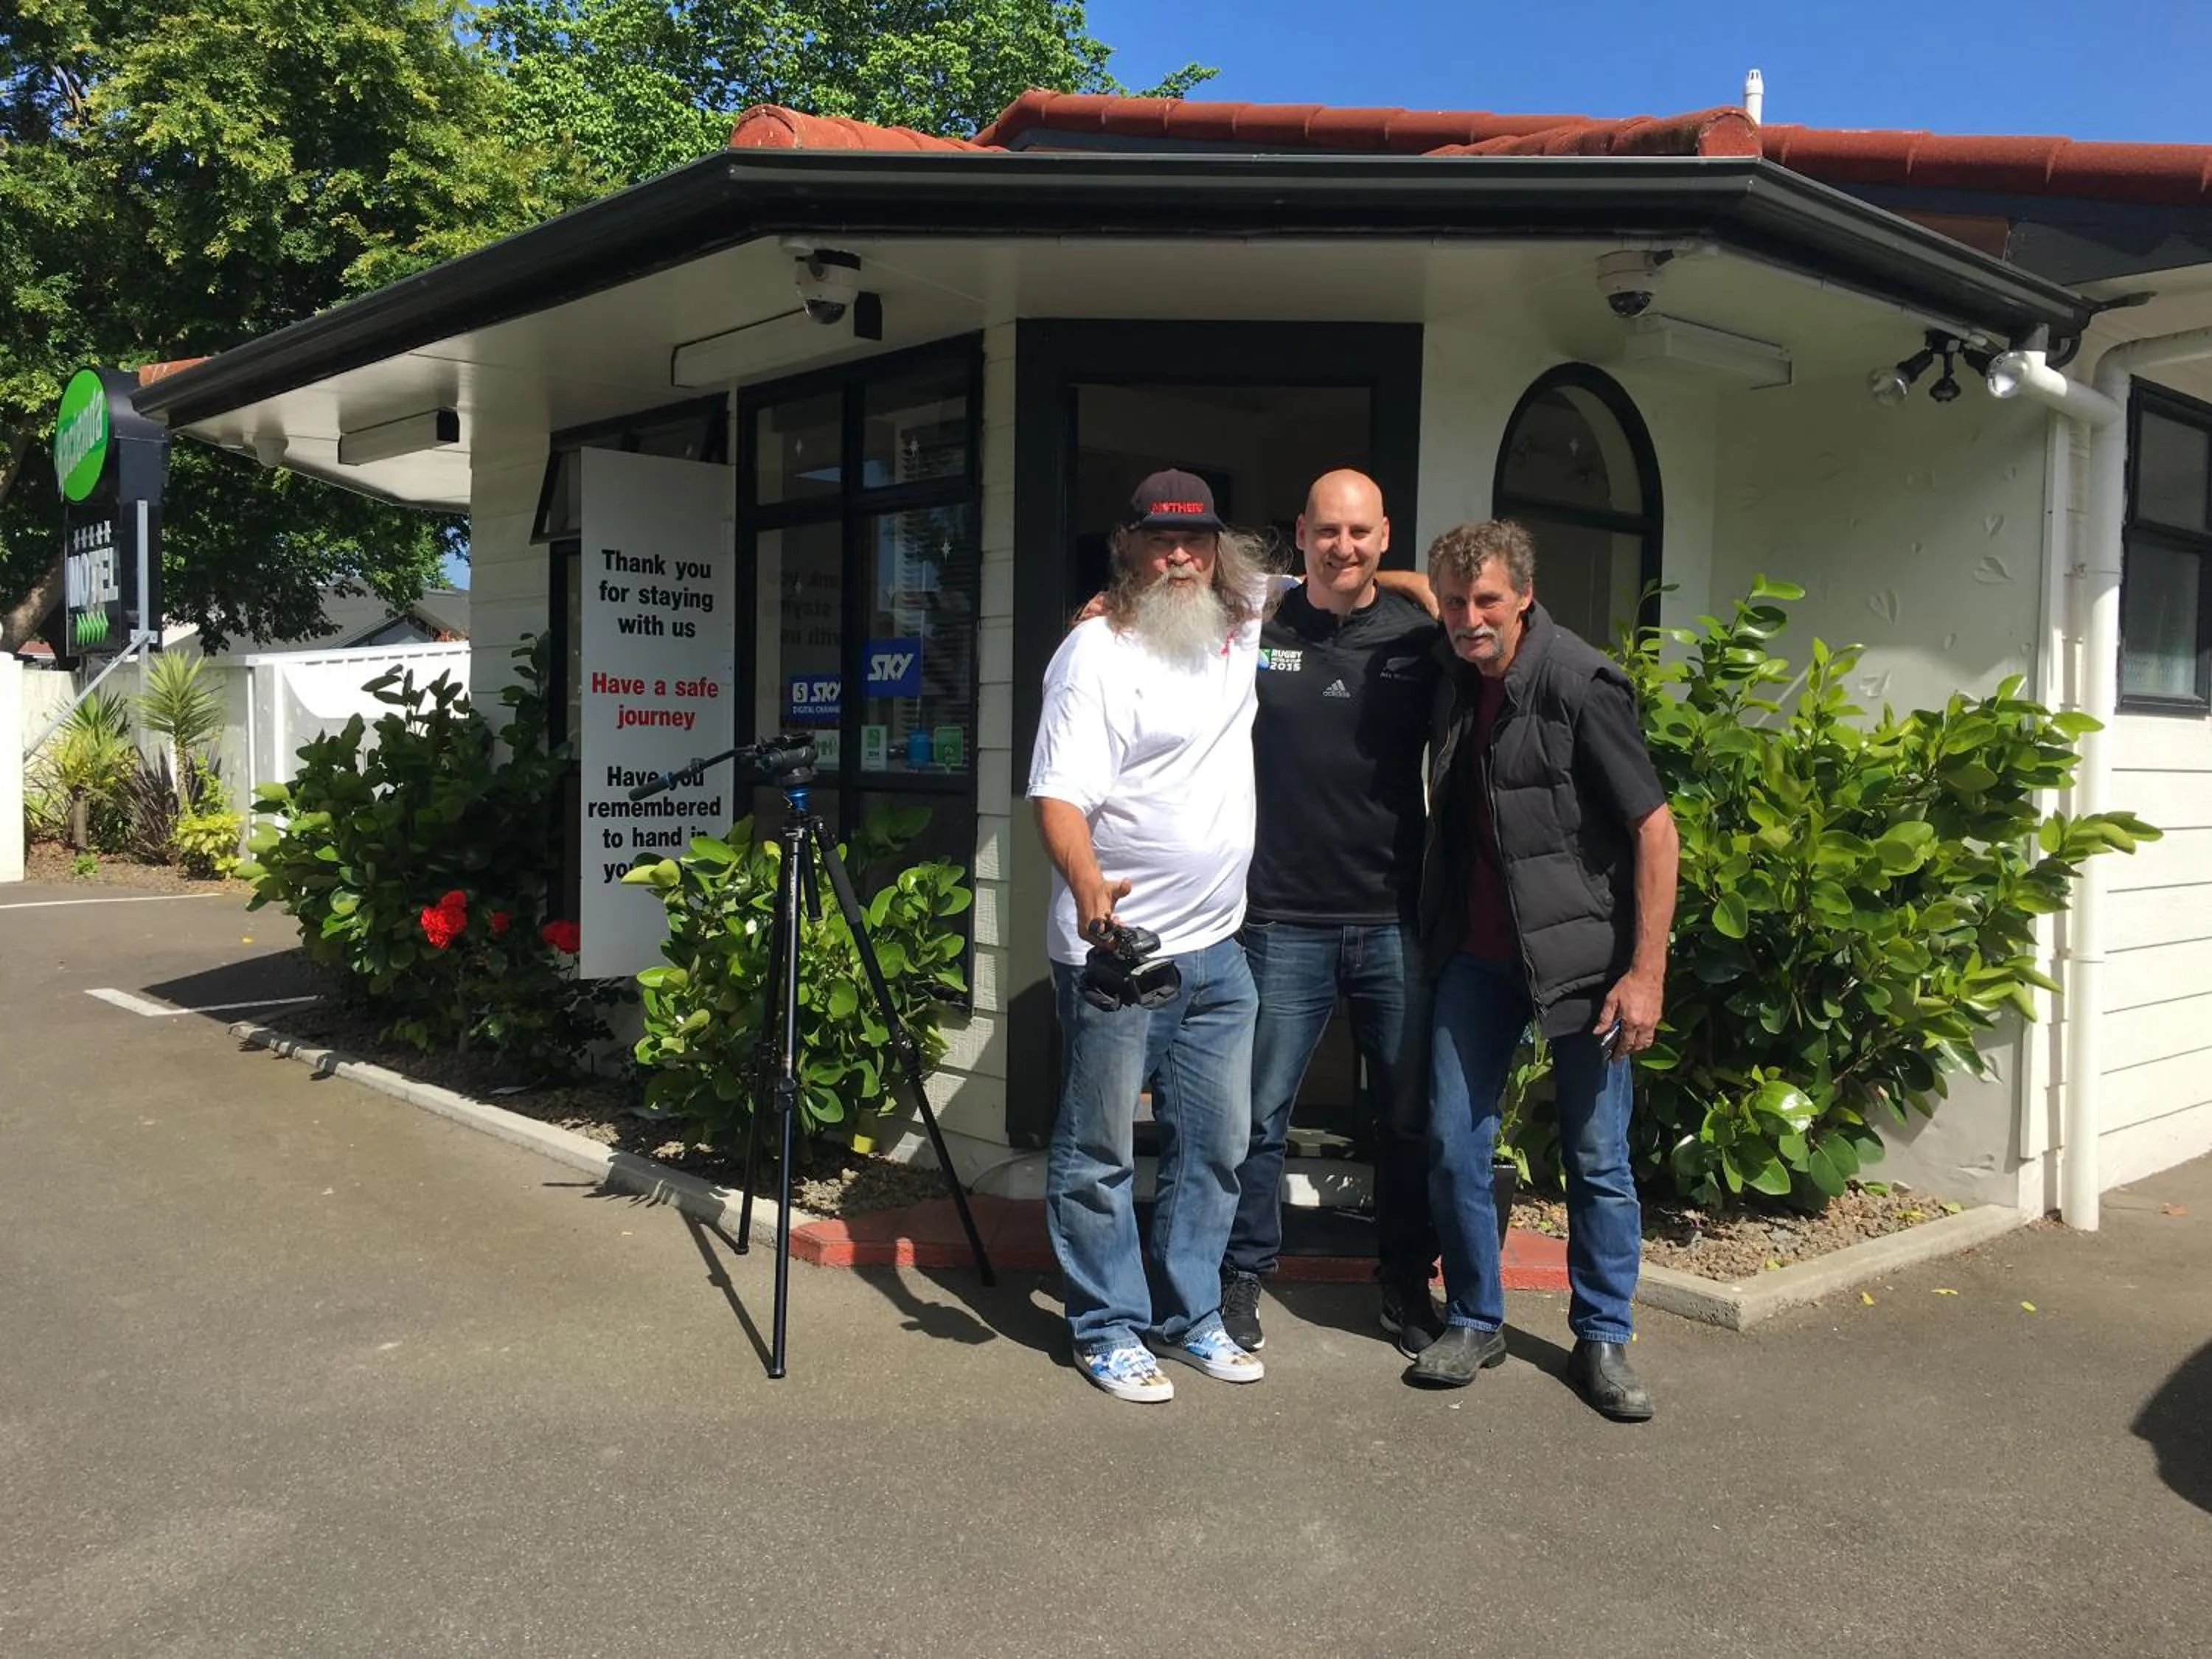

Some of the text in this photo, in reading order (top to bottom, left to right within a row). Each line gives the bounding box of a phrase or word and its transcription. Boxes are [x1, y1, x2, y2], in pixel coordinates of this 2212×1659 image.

[601, 549, 712, 580] Thank you
[67, 547, 118, 608] MOTEL
[599, 580, 714, 613] for staying
[618, 613, 695, 638] with us
[1270, 649, 1303, 658] RUGBY
[867, 653, 915, 681] SKY
[1270, 662, 1301, 672] 2015
[592, 672, 719, 698] Have a safe
[810, 681, 841, 703] SKY
[616, 704, 696, 731] journey
[607, 766, 658, 787] Have
[588, 796, 721, 817] remembered
[602, 828, 623, 849] to
[632, 826, 682, 847] hand
